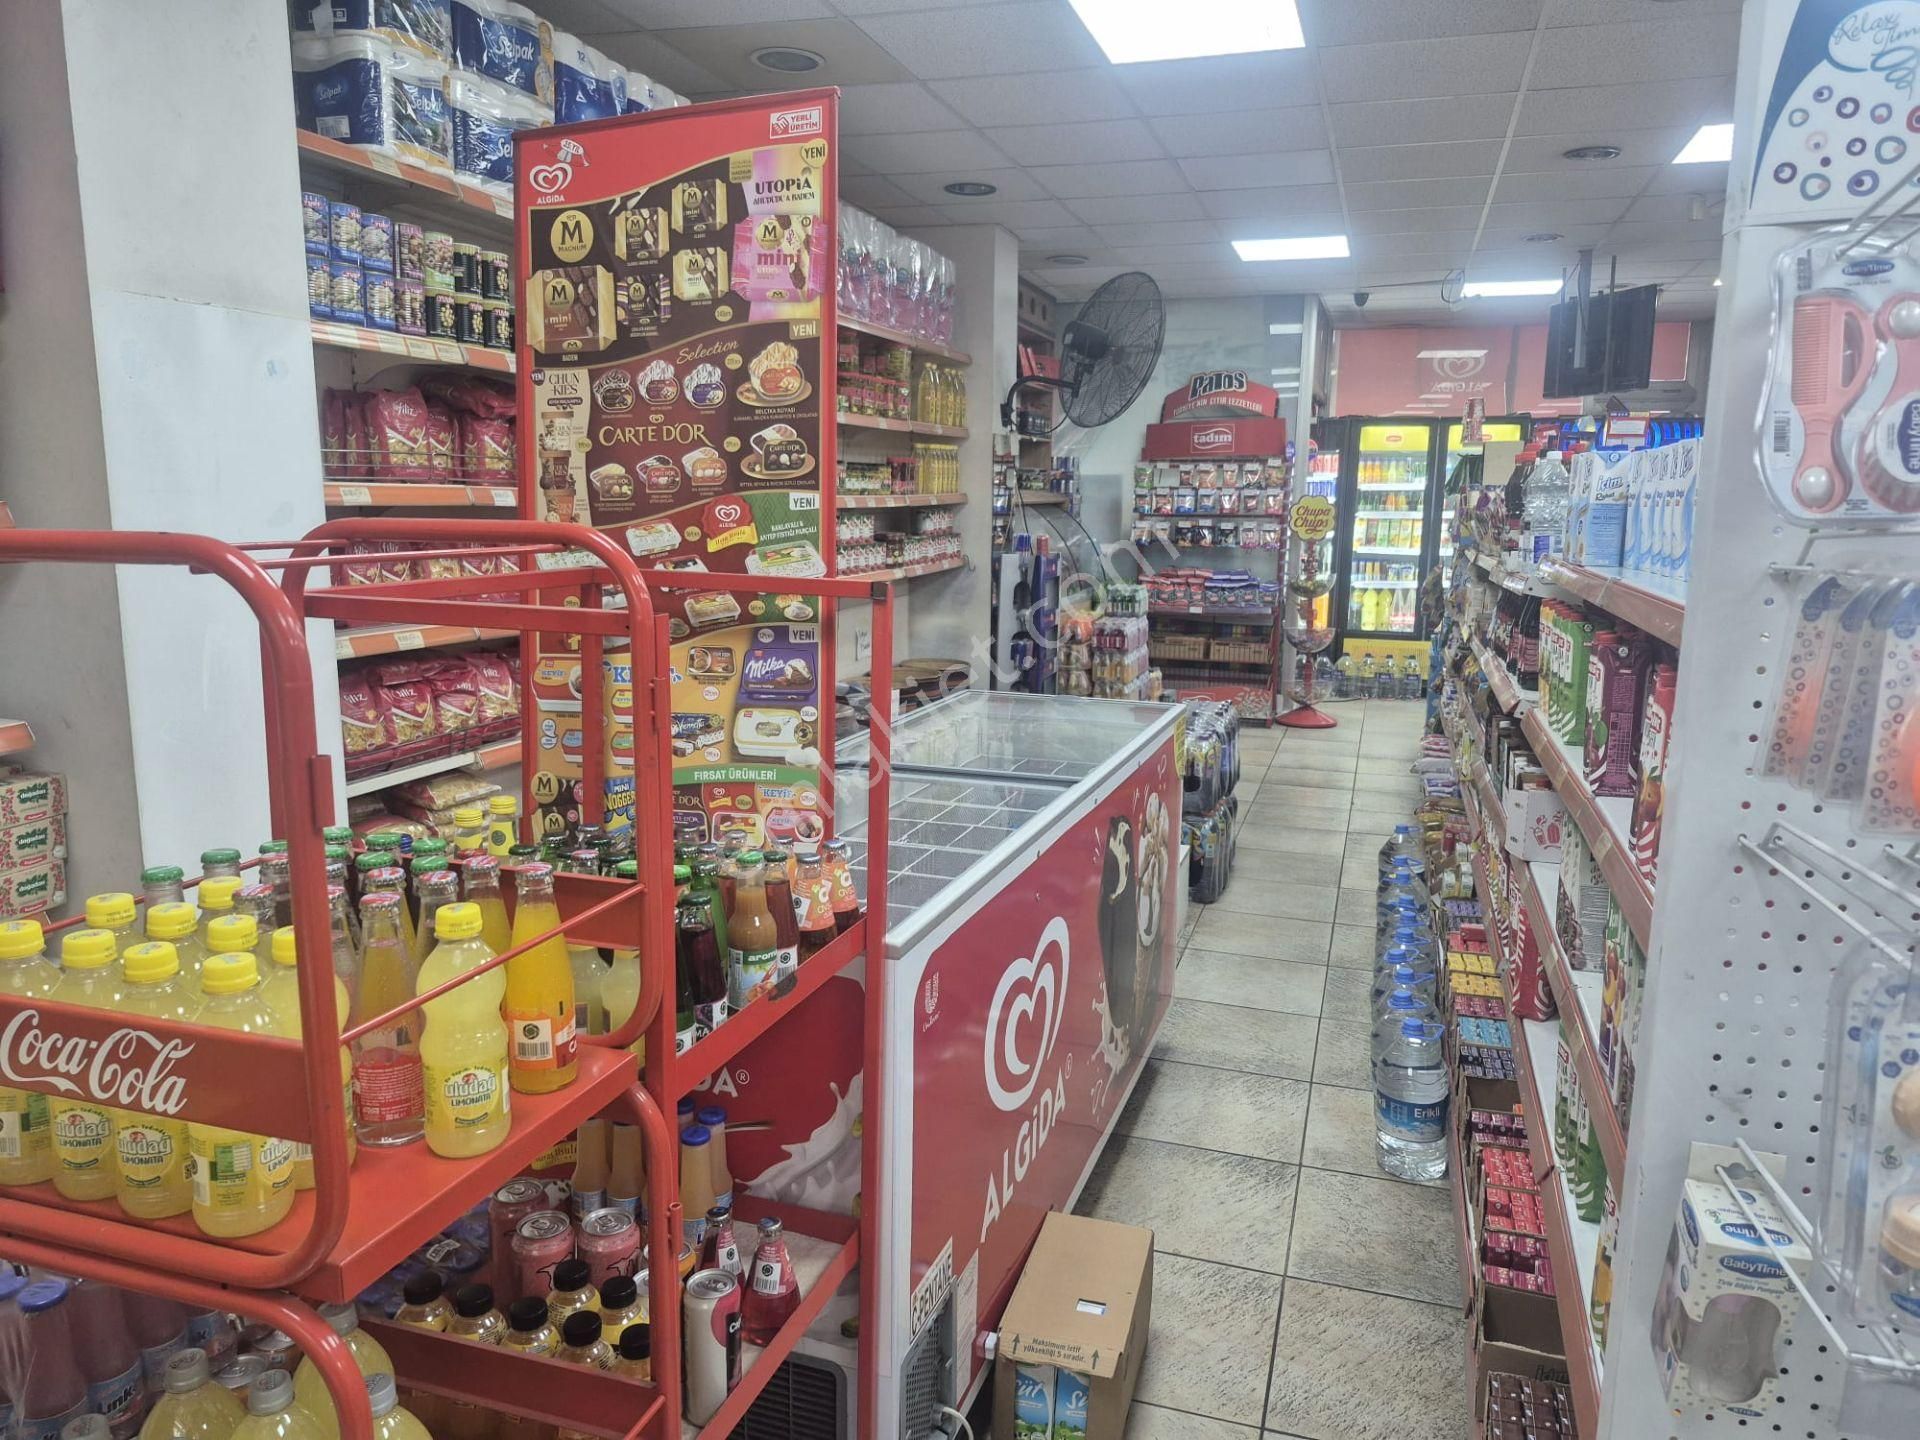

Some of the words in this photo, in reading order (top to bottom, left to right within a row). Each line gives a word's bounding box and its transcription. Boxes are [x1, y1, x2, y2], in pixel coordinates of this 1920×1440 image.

[497, 34, 535, 61] Selpak
[804, 143, 826, 160] YENİ
[558, 243, 587, 252] MAGNUM
[792, 321, 816, 337] YENİ
[676, 340, 739, 365] Selection
[599, 425, 658, 446] CARTE
[793, 497, 816, 509] YENİ
[1296, 506, 1331, 518] Chupa
[1294, 515, 1330, 534] Chups
[792, 629, 815, 641] YENİ
[746, 657, 785, 679] Milka
[694, 770, 727, 781] FIRSAT
[729, 768, 777, 782] ÜRÜNLERİ
[0, 1009, 196, 1115] Coca-Cola
